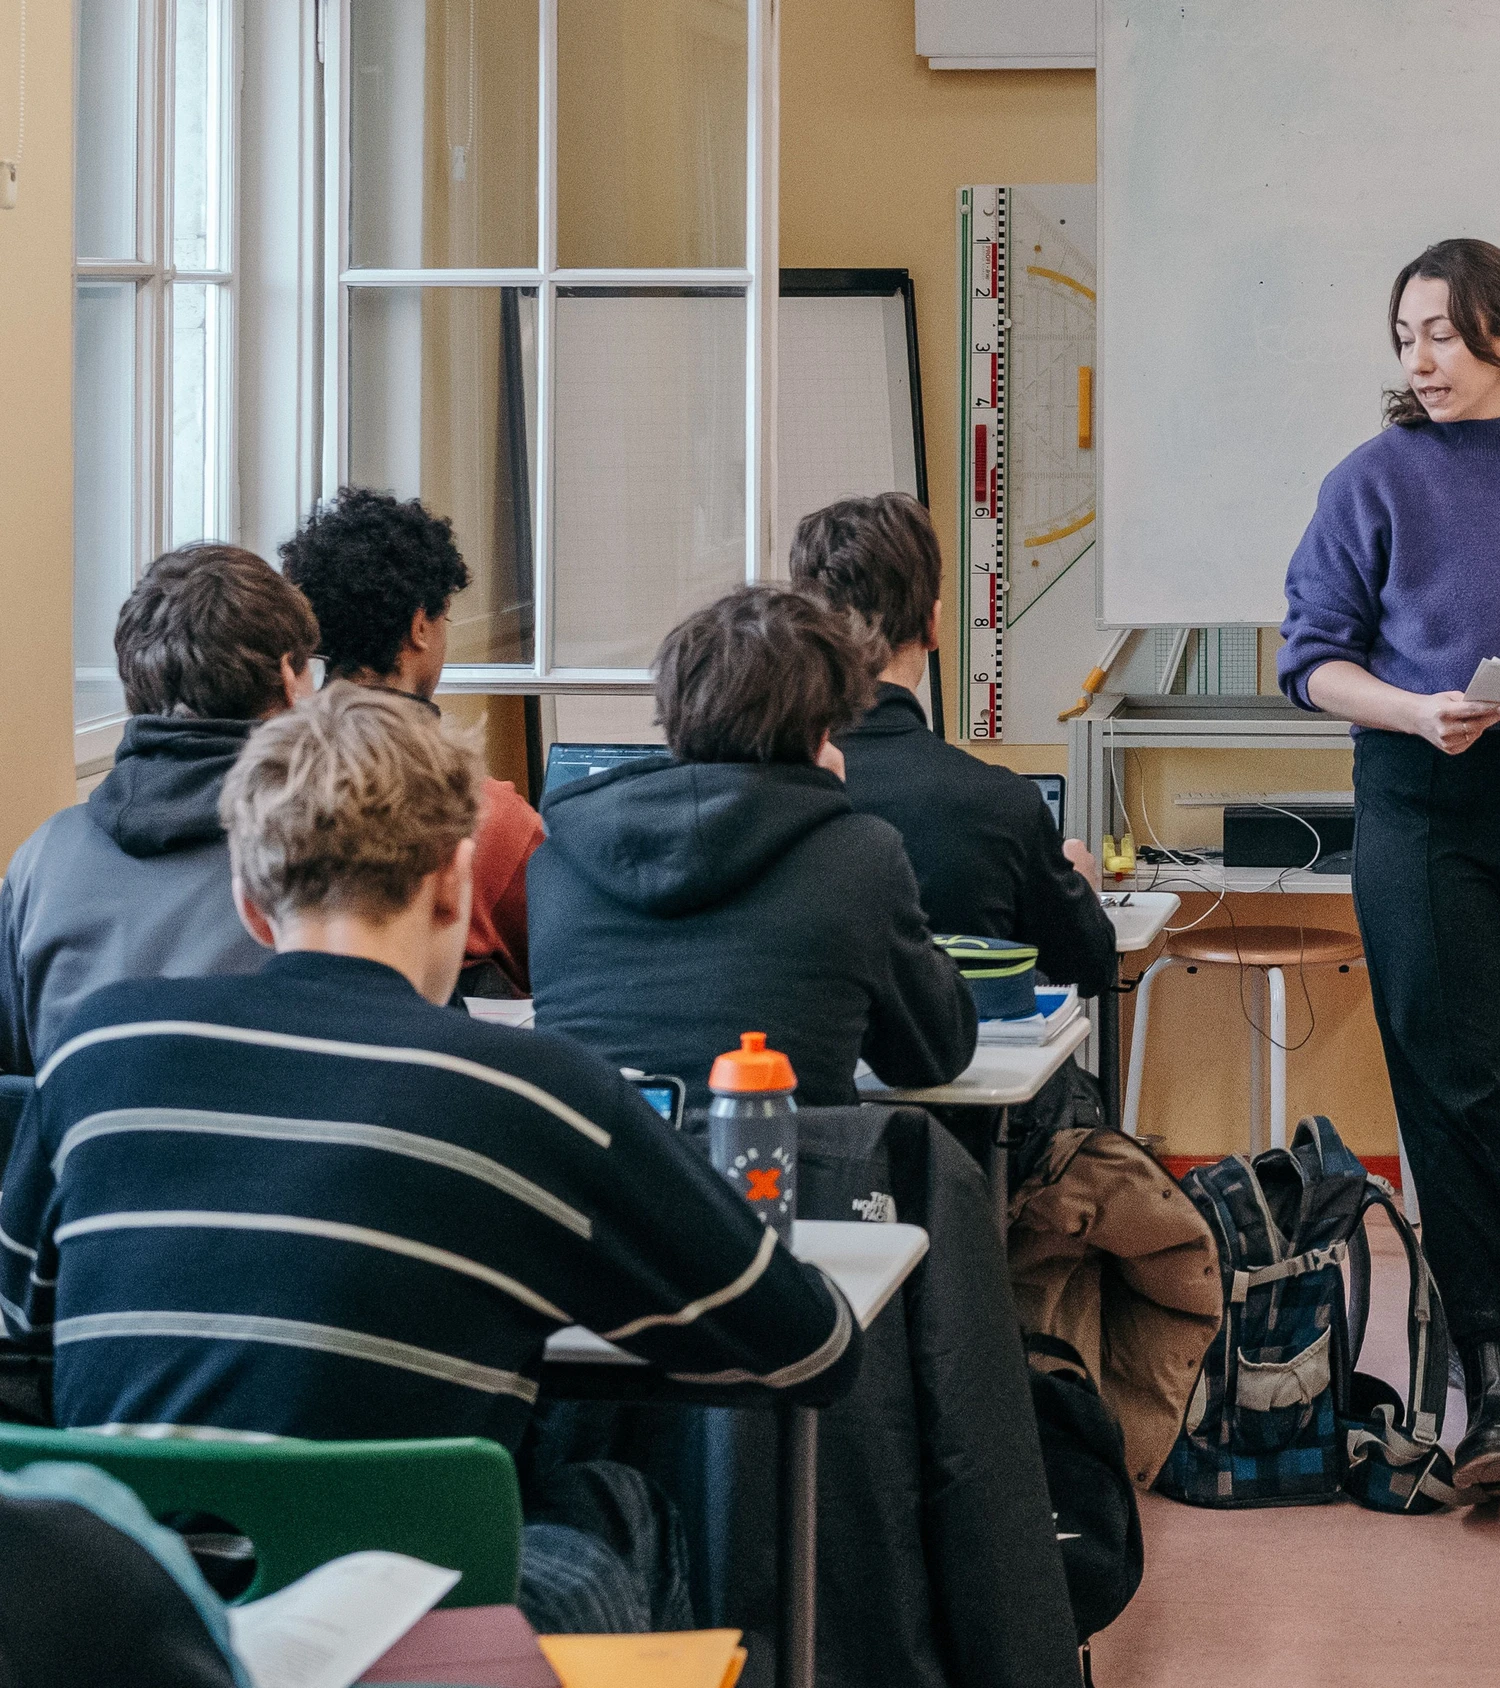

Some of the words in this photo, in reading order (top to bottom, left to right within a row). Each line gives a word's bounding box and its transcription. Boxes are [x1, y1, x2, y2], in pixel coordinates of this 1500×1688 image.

[975, 288, 991, 297] 2
[975, 343, 991, 352] 3
[975, 397, 991, 407] 4
[975, 507, 990, 517] 6
[975, 562, 990, 572] 7
[974, 618, 989, 627] 8
[974, 672, 989, 682] 9
[973, 719, 989, 737] 10
